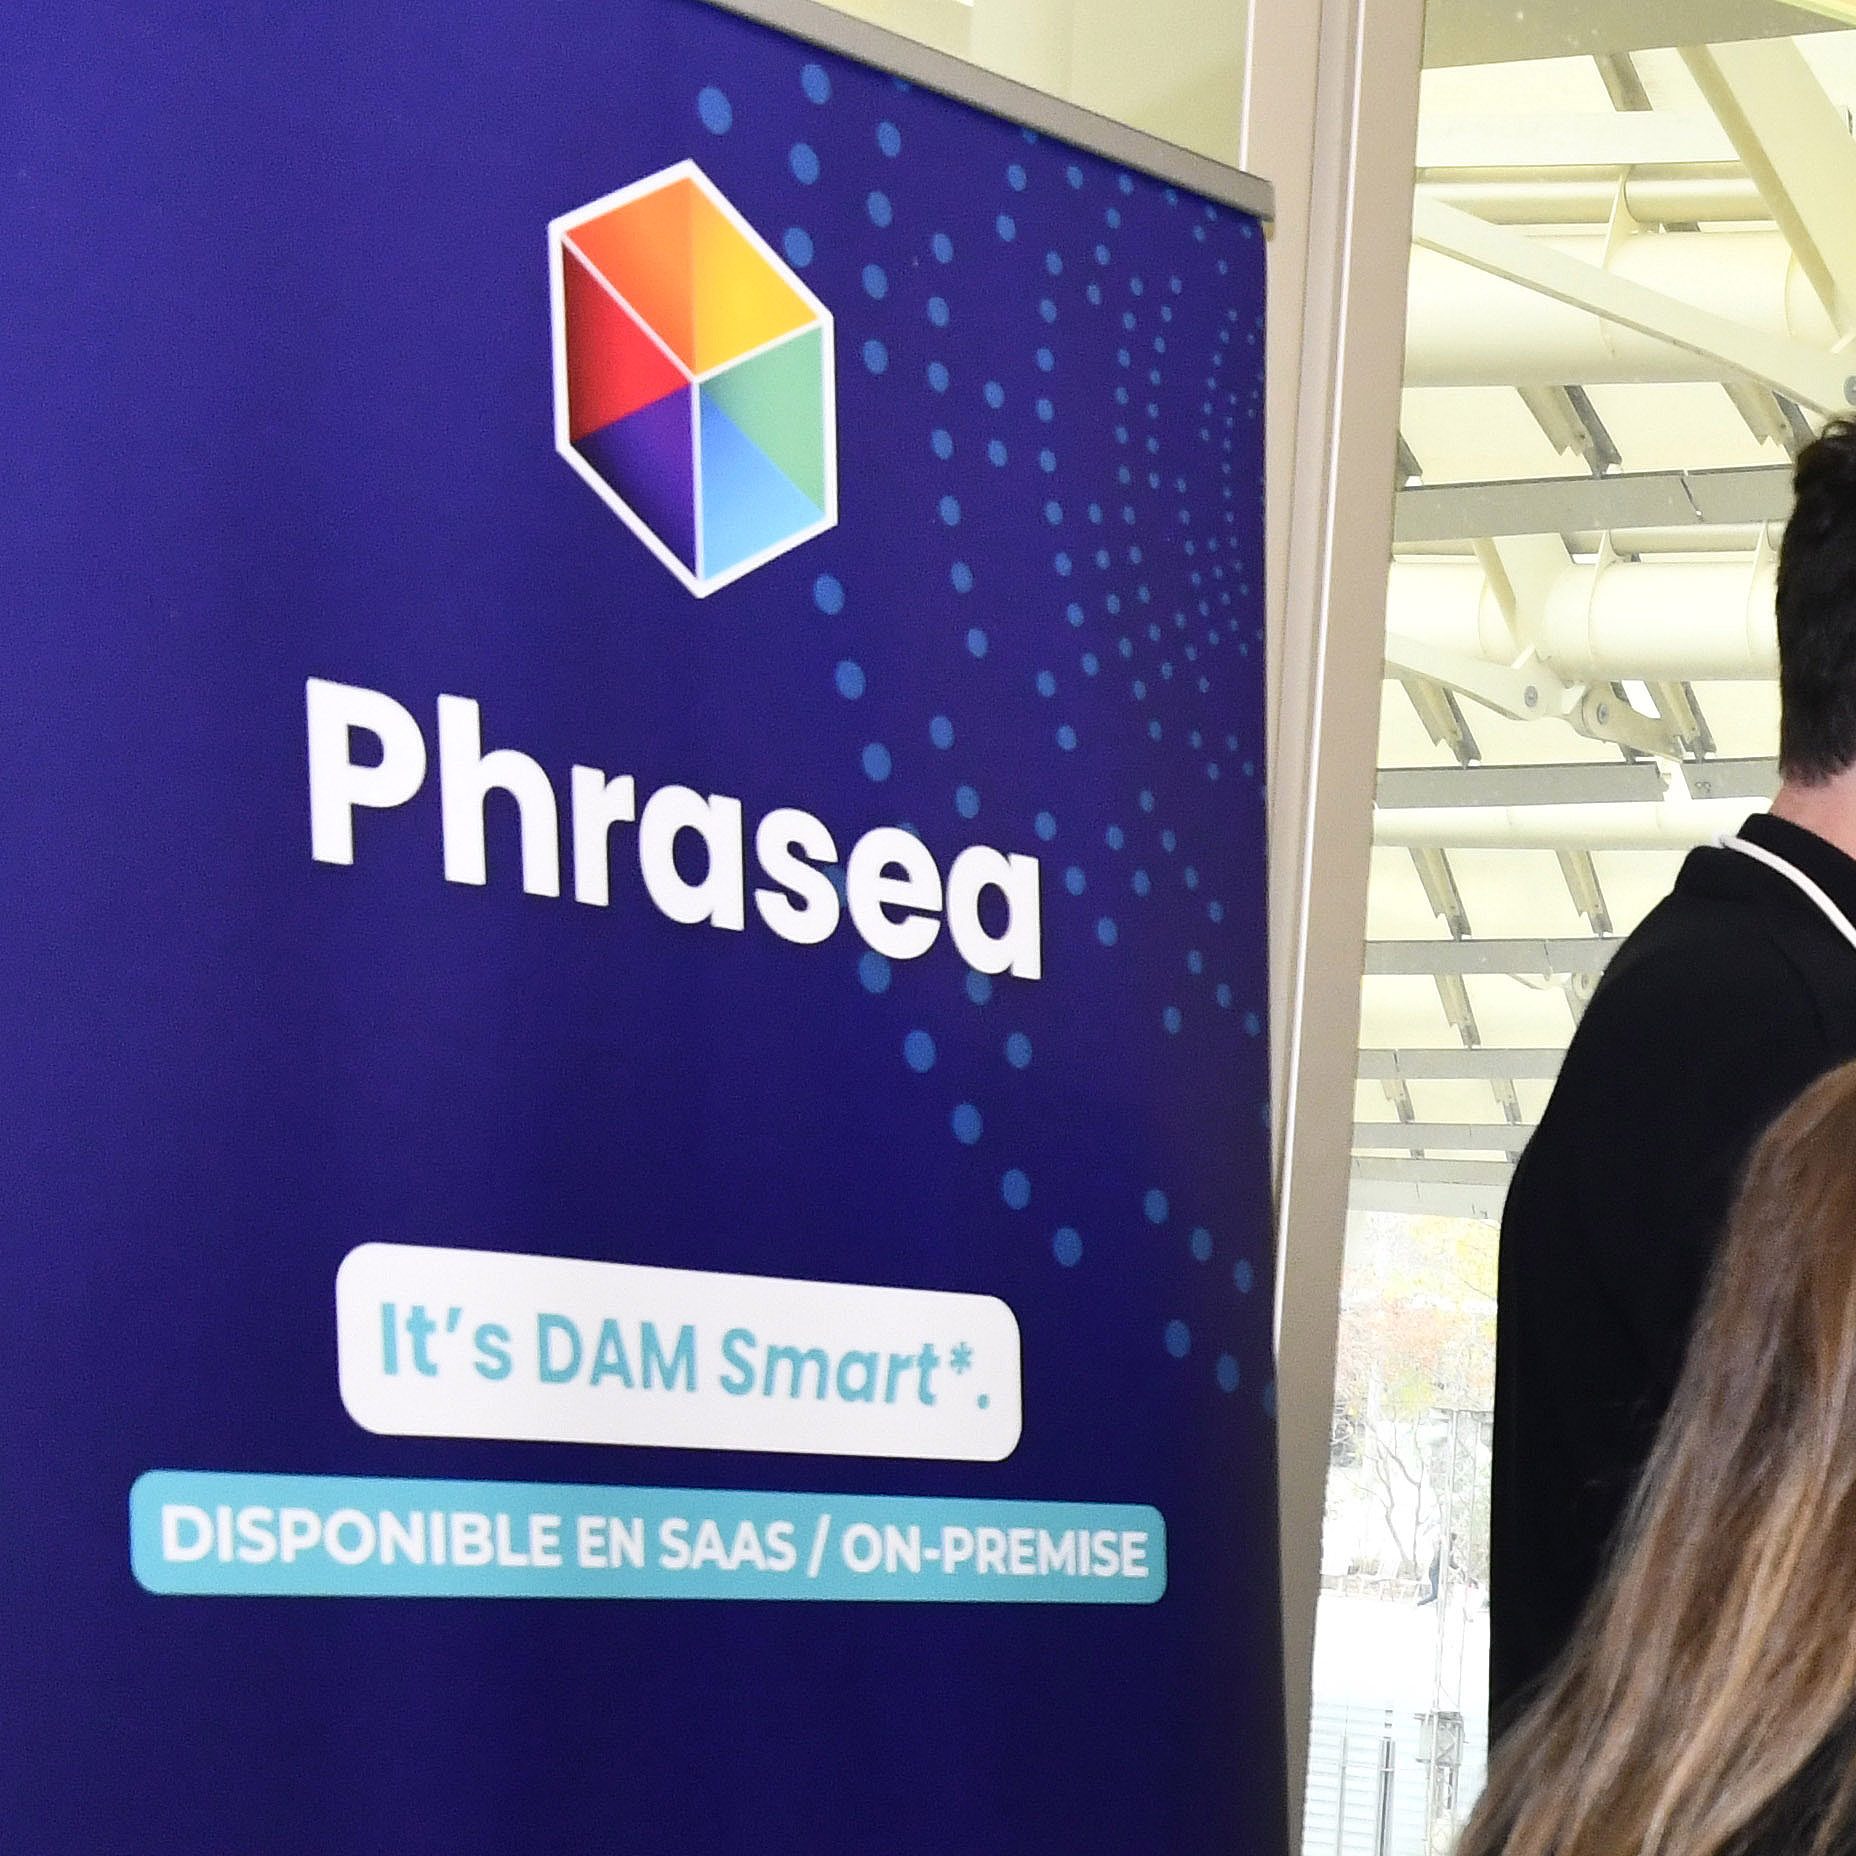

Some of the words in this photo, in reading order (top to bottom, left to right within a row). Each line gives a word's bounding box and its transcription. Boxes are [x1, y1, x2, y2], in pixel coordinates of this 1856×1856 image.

[306, 678, 1040, 979] Phrasea
[381, 1303, 513, 1381] It’s
[538, 1313, 696, 1392] DAM
[162, 1504, 562, 1567] DISPONIBLE
[577, 1516, 644, 1568] EN
[659, 1518, 797, 1571] SAAS
[807, 1514, 831, 1578] /
[841, 1523, 1148, 1577] ON-PREMISE
